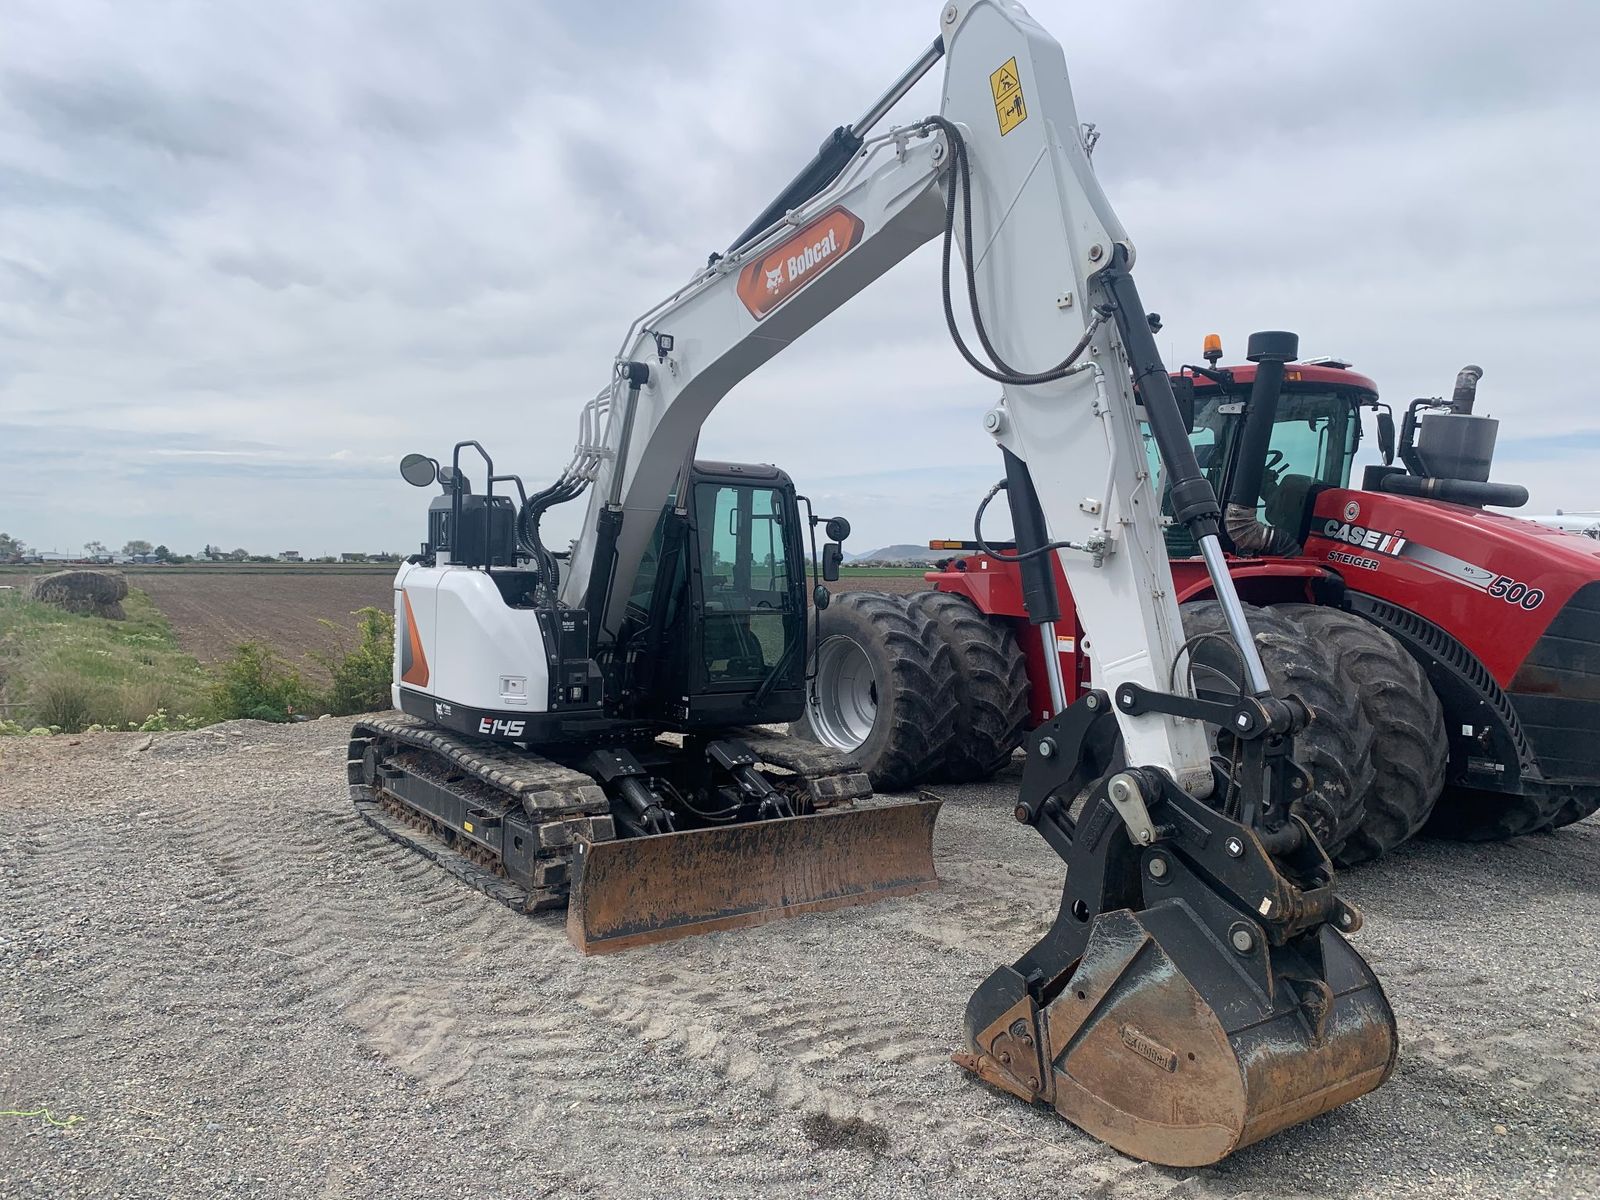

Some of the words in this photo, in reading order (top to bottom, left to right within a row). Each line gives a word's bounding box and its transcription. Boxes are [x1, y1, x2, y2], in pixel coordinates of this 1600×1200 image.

[787, 228, 837, 282] Bobcat
[1324, 520, 1382, 549] CASE
[1328, 551, 1379, 571] STEIGER
[1488, 575, 1544, 610] 500
[479, 717, 526, 737] E145
